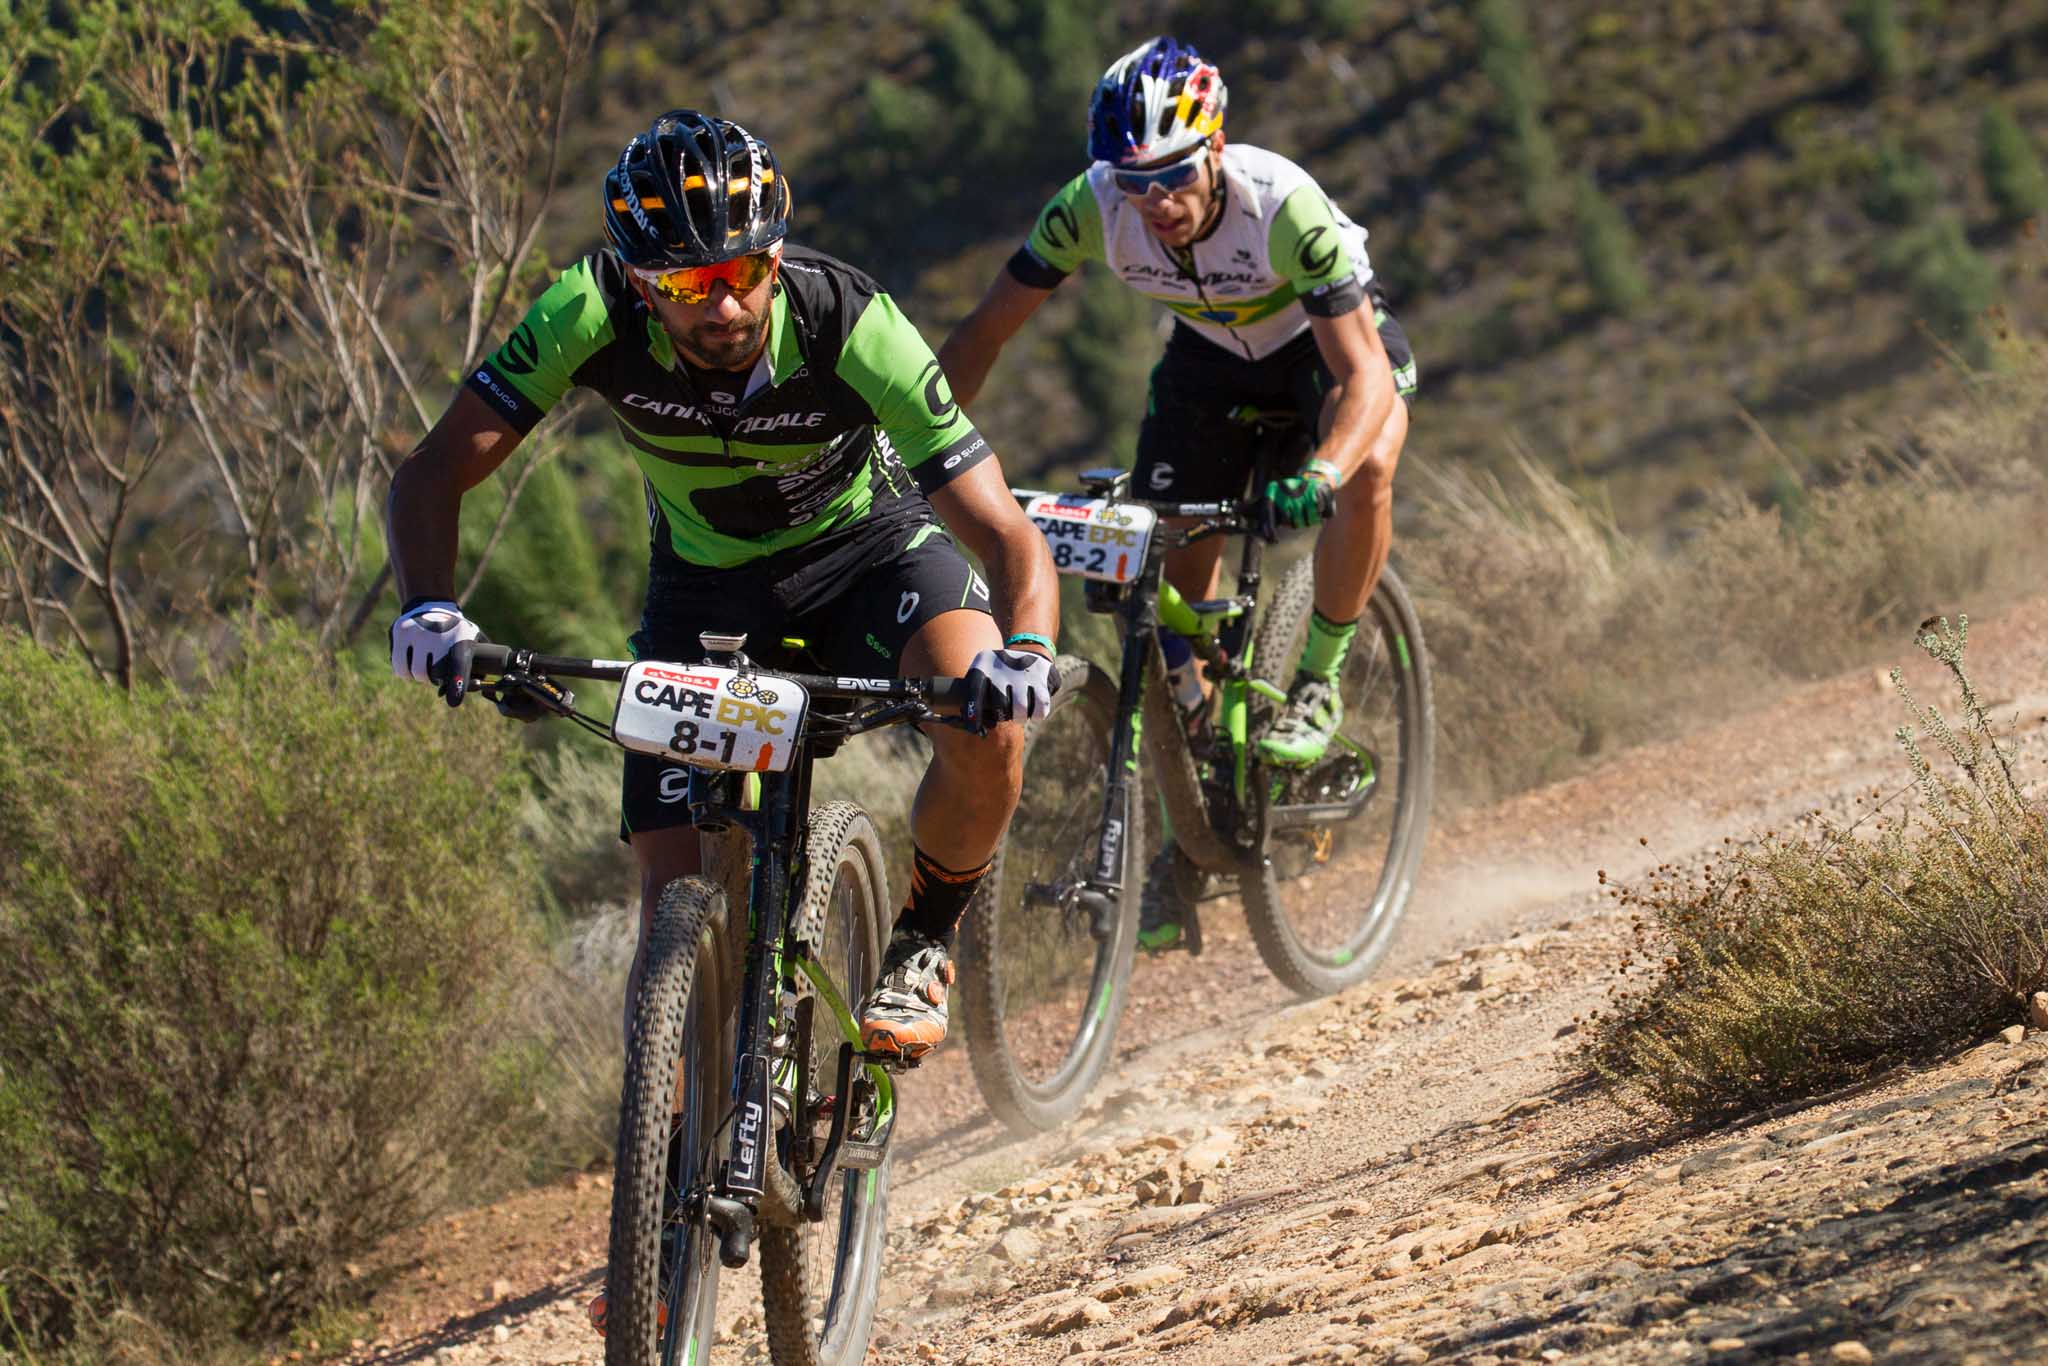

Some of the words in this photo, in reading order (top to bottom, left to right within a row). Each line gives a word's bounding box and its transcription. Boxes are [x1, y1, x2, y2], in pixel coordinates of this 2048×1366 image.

[1032, 516, 1085, 541] CAPE
[1088, 524, 1137, 548] EPIC
[1053, 543, 1107, 574] 8-2
[634, 679, 715, 719] CAPE
[715, 696, 787, 736] EPIC
[668, 719, 738, 764] 8-1
[1097, 818, 1122, 879] Lefty
[733, 1101, 763, 1181] Lefty
